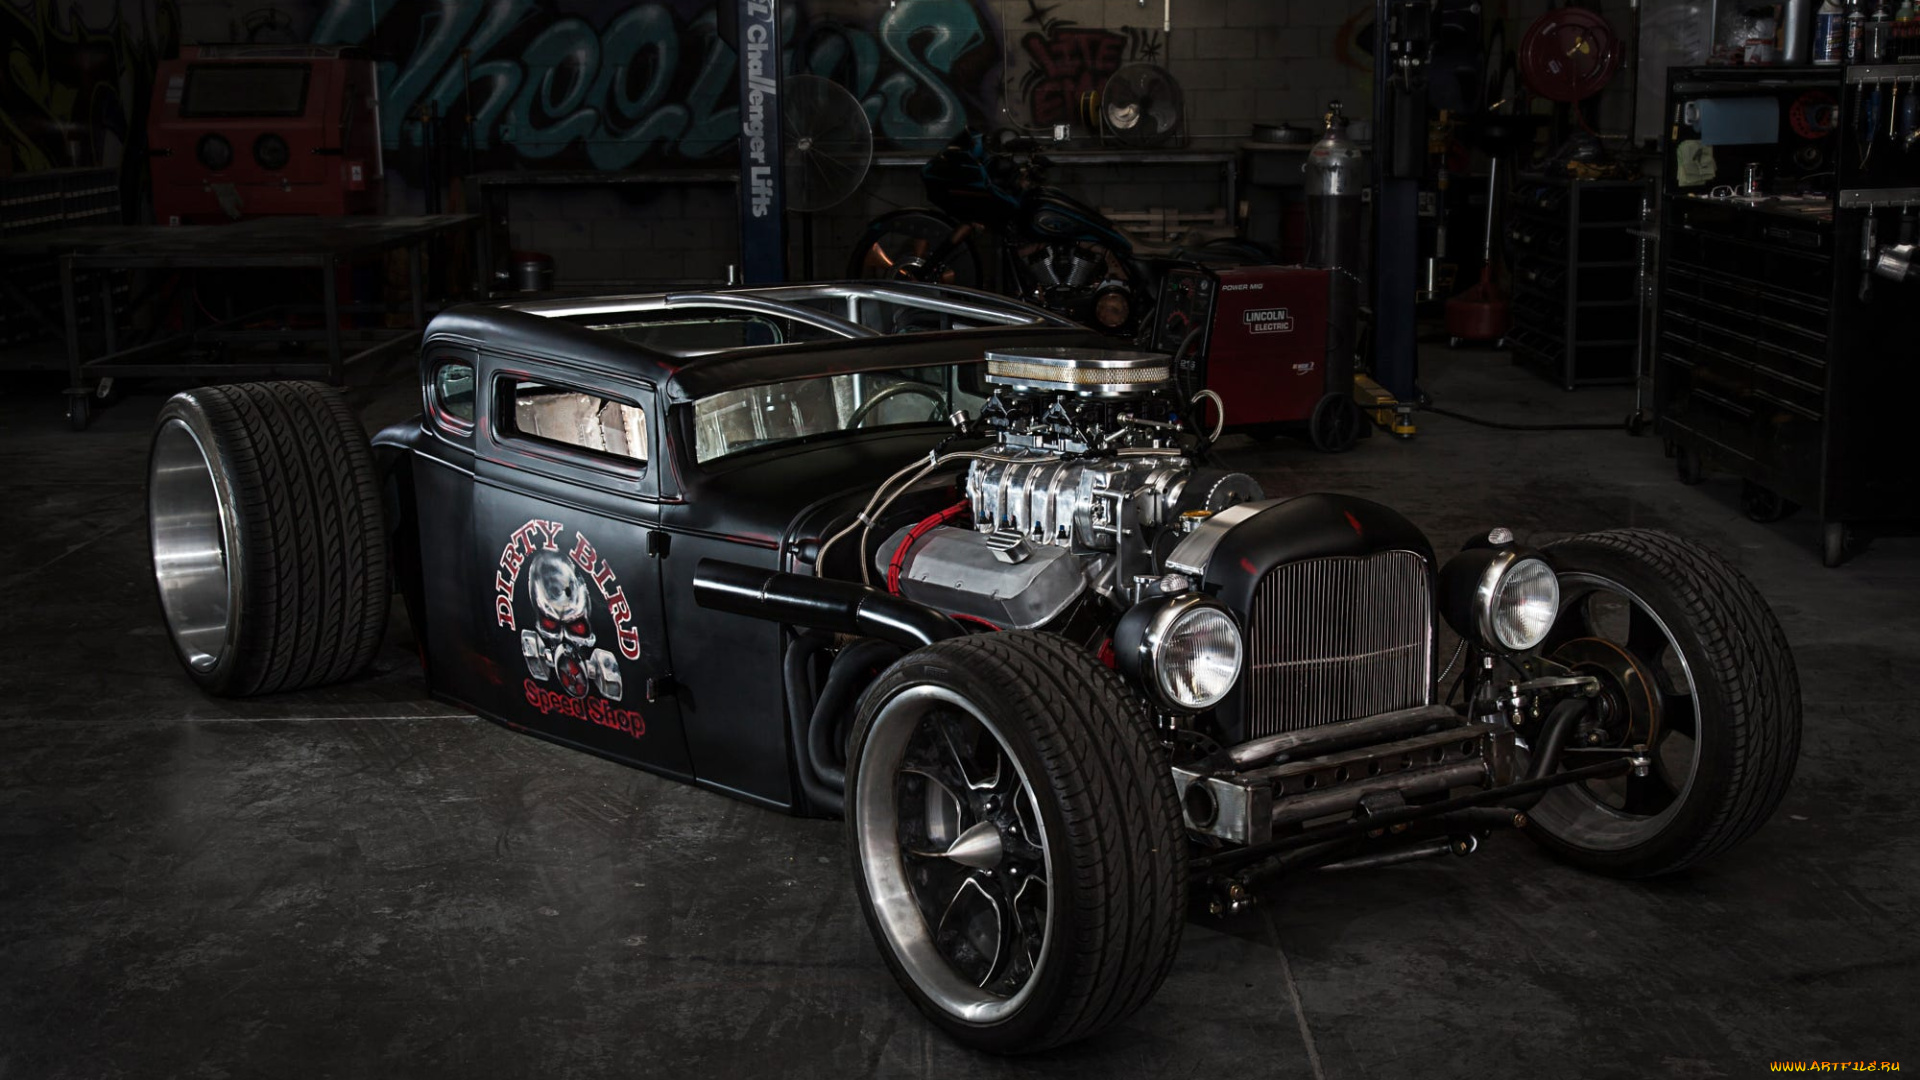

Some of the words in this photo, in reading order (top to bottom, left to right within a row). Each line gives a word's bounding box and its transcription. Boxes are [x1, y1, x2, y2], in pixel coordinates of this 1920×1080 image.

[743, 24, 777, 164] Challenger
[750, 166, 773, 218] Lifts
[1221, 283, 1248, 292] POWER
[1245, 310, 1286, 323] LINCOLN
[1254, 322, 1289, 332] ELECTRIC
[496, 519, 564, 631] DIRTY
[569, 531, 641, 661] BIRD
[523, 677, 588, 721] Speed
[587, 695, 646, 739] Shop
